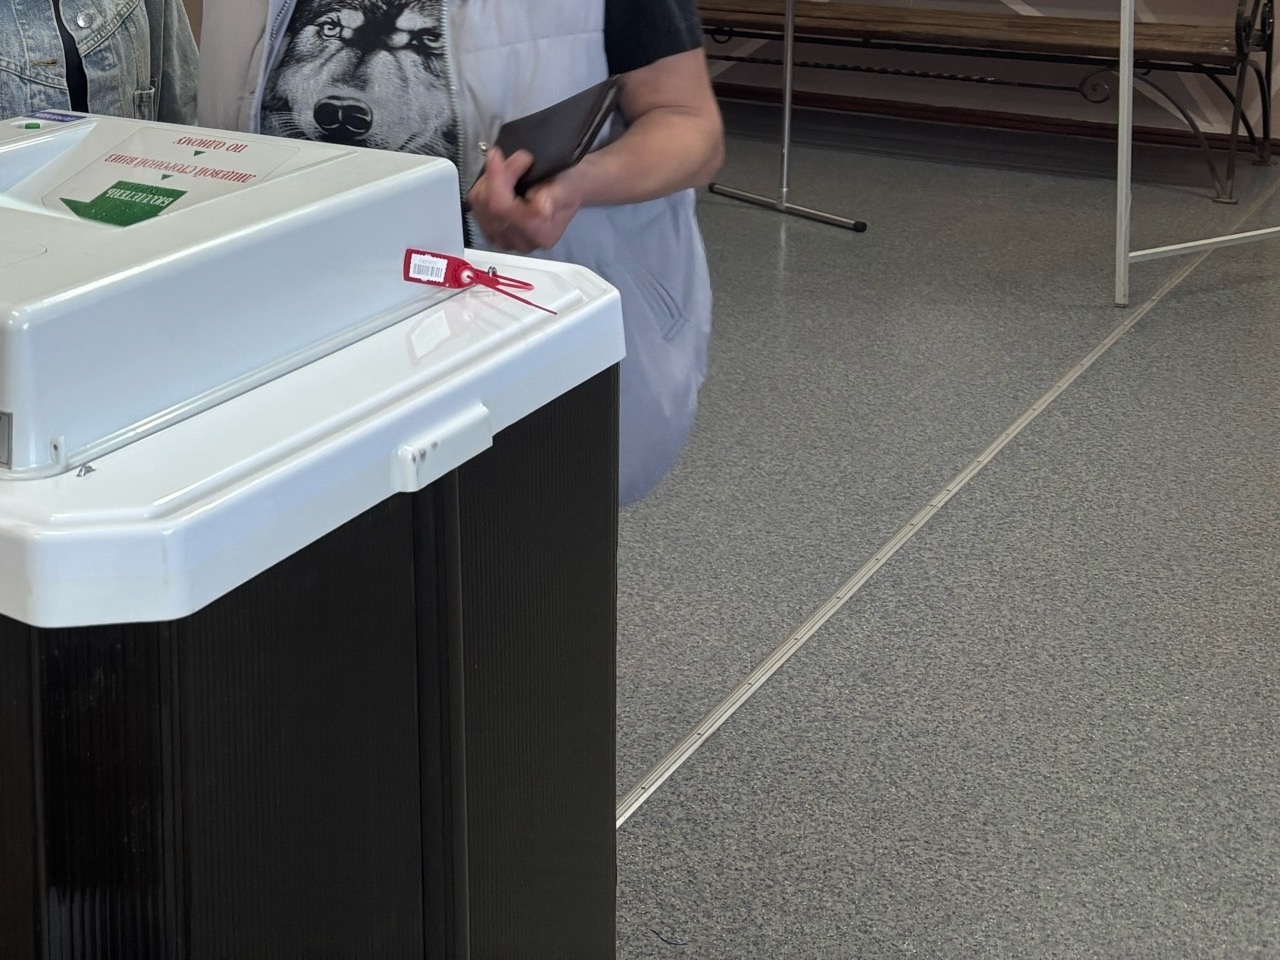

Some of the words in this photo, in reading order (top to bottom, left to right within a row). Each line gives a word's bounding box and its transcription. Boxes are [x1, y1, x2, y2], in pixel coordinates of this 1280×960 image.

[173, 135, 226, 150] ОДНОМУ
[226, 143, 249, 153] ПО
[105, 153, 141, 165] ВНИЗ
[134, 156, 198, 174] СТОРОНОЙ
[194, 165, 257, 183] ЛИЦЕВОЙ
[105, 187, 174, 207] БЮЛЛЕТЕНЬ
